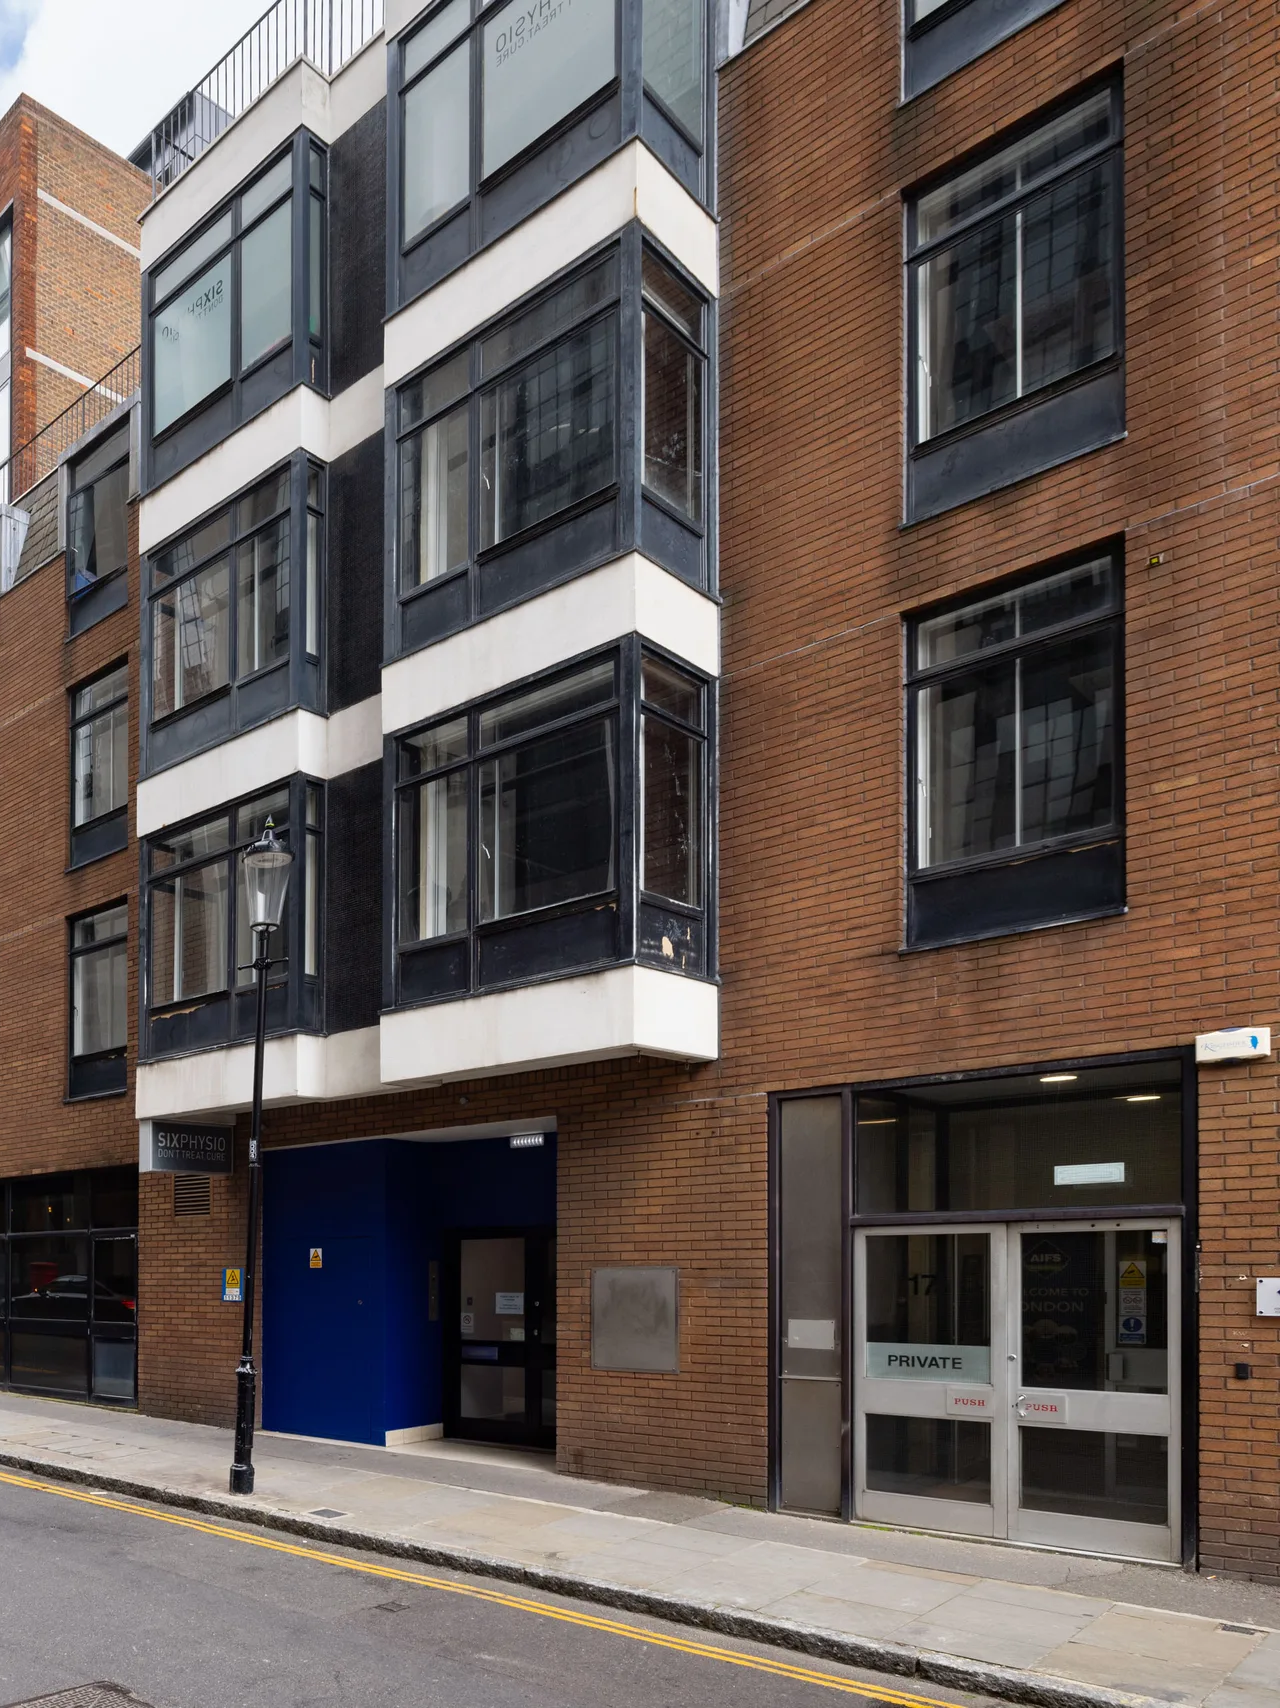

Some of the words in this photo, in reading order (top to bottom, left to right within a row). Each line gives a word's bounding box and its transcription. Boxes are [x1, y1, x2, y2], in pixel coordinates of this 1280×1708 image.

[158, 1132, 226, 1152] SIXPHYSIO
[1030, 1253, 1061, 1263] AIFS
[908, 1273, 936, 1296] 17
[1023, 1288, 1069, 1297] LCOME
[1021, 1301, 1084, 1312] ONDON
[888, 1354, 962, 1370] PRIVATE
[954, 1398, 986, 1407] PUSH
[1025, 1403, 1058, 1412] PUSH
